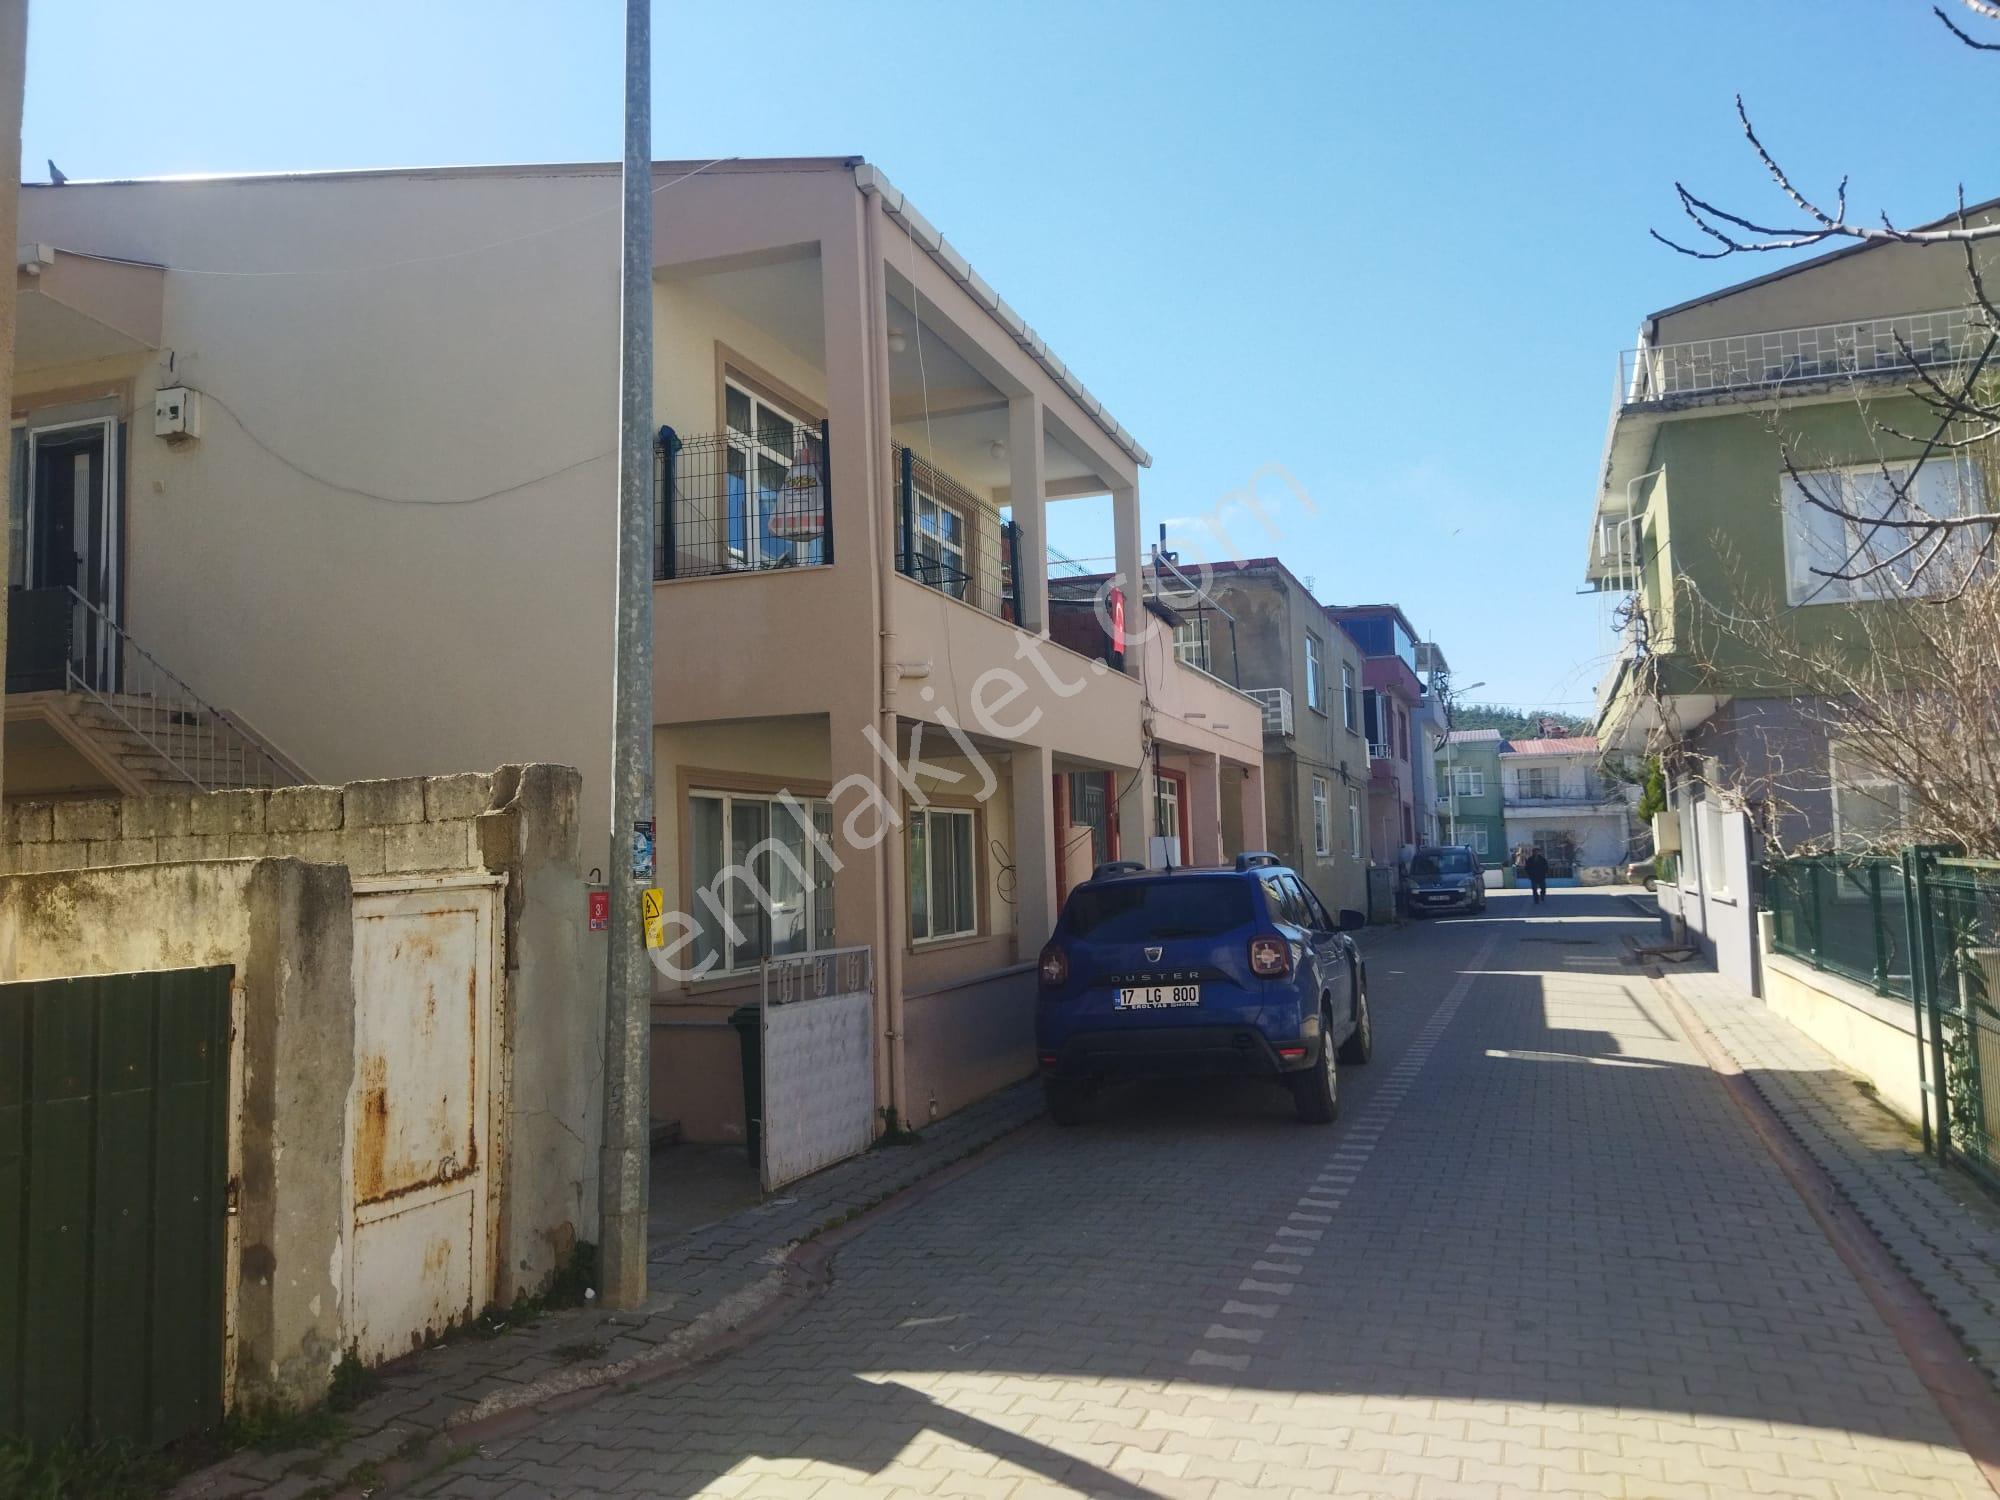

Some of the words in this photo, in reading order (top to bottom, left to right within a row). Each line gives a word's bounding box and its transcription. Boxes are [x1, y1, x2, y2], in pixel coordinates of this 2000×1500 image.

[1112, 971, 1199, 982] DUSTER
[1122, 990, 1134, 1004] 17
[1146, 989, 1161, 1003] LG
[1173, 987, 1196, 1001] 800
